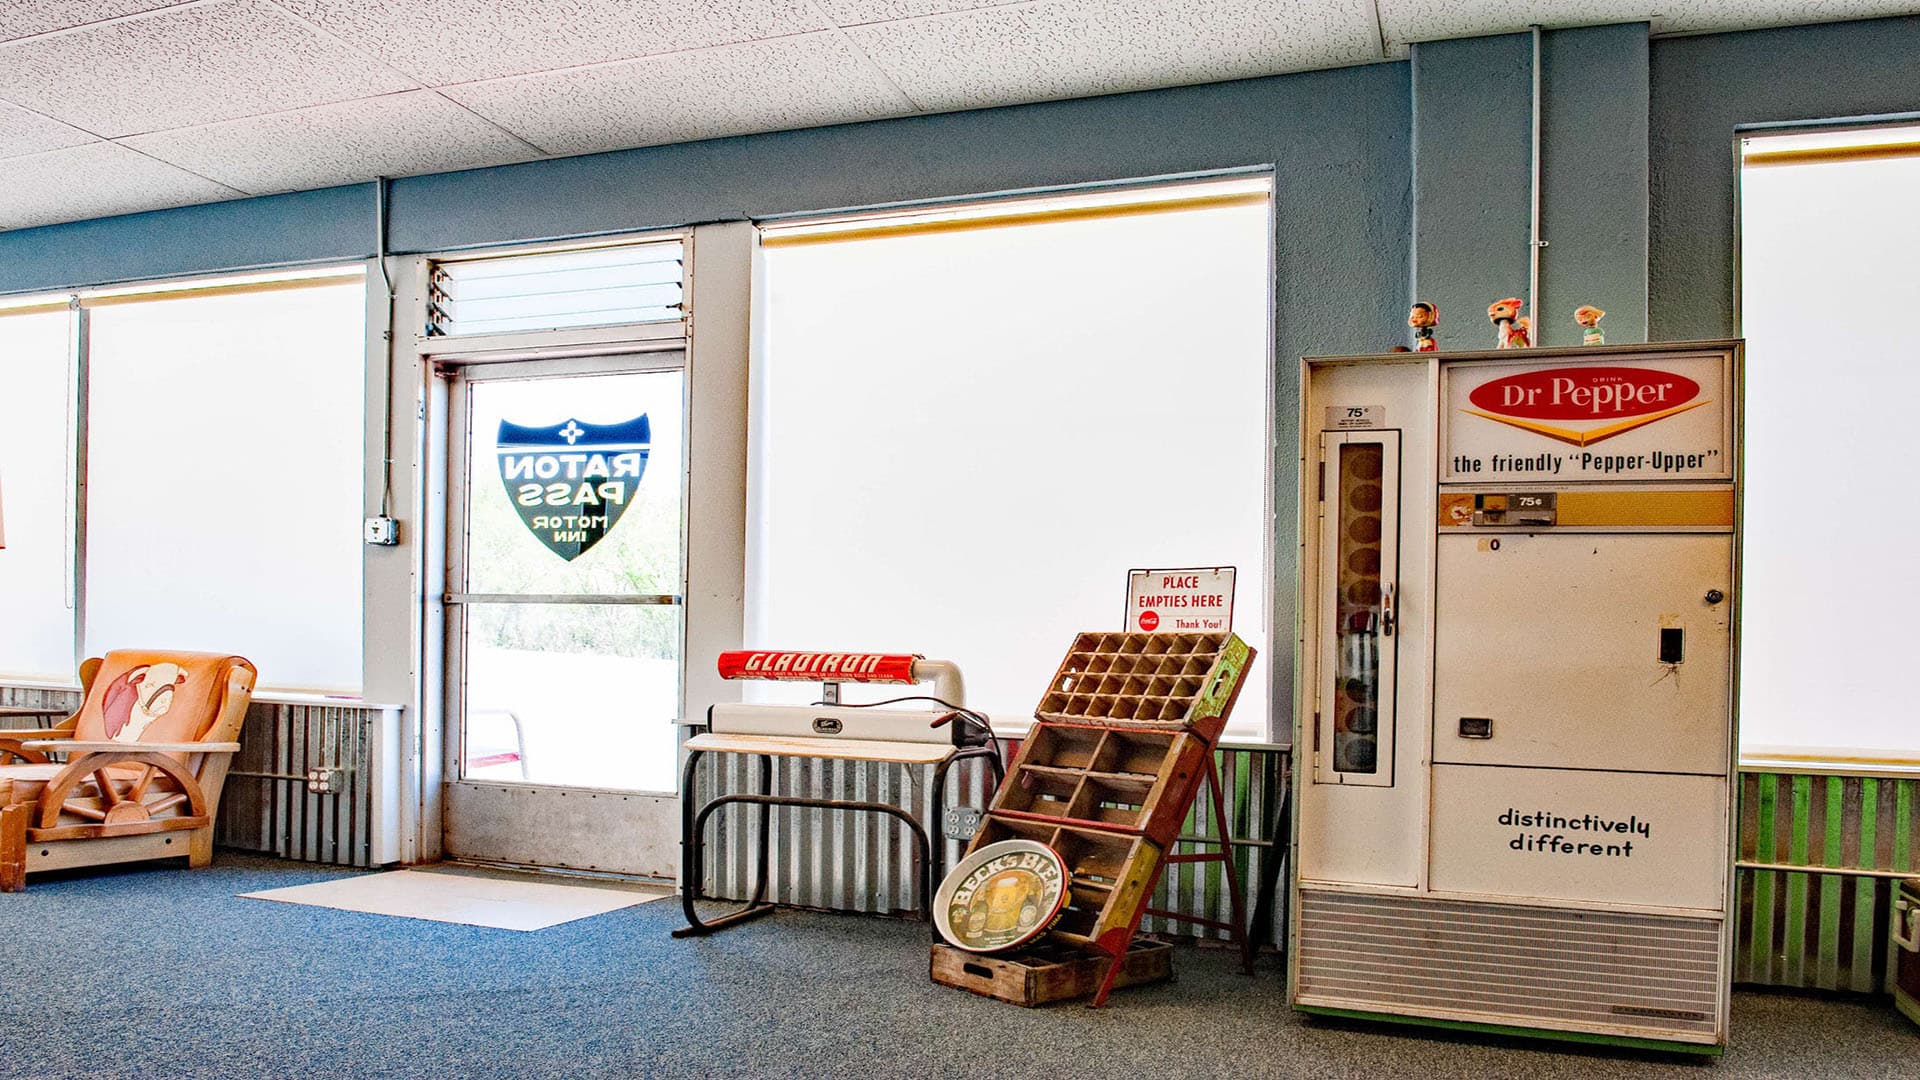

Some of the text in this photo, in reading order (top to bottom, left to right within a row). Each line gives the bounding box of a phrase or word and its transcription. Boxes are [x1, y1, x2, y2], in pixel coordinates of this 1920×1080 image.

[1501, 377, 1673, 414] Dr Pepper
[1453, 449, 1719, 475] the friendly "Pepper-Upper"
[1163, 575, 1199, 589] PLACE
[1138, 594, 1223, 608] EMPTIES HERE
[1176, 619, 1222, 629] Thank You!
[744, 653, 885, 673] GLADIRON
[1498, 807, 1651, 838] distinctively
[1509, 832, 1633, 858] different
